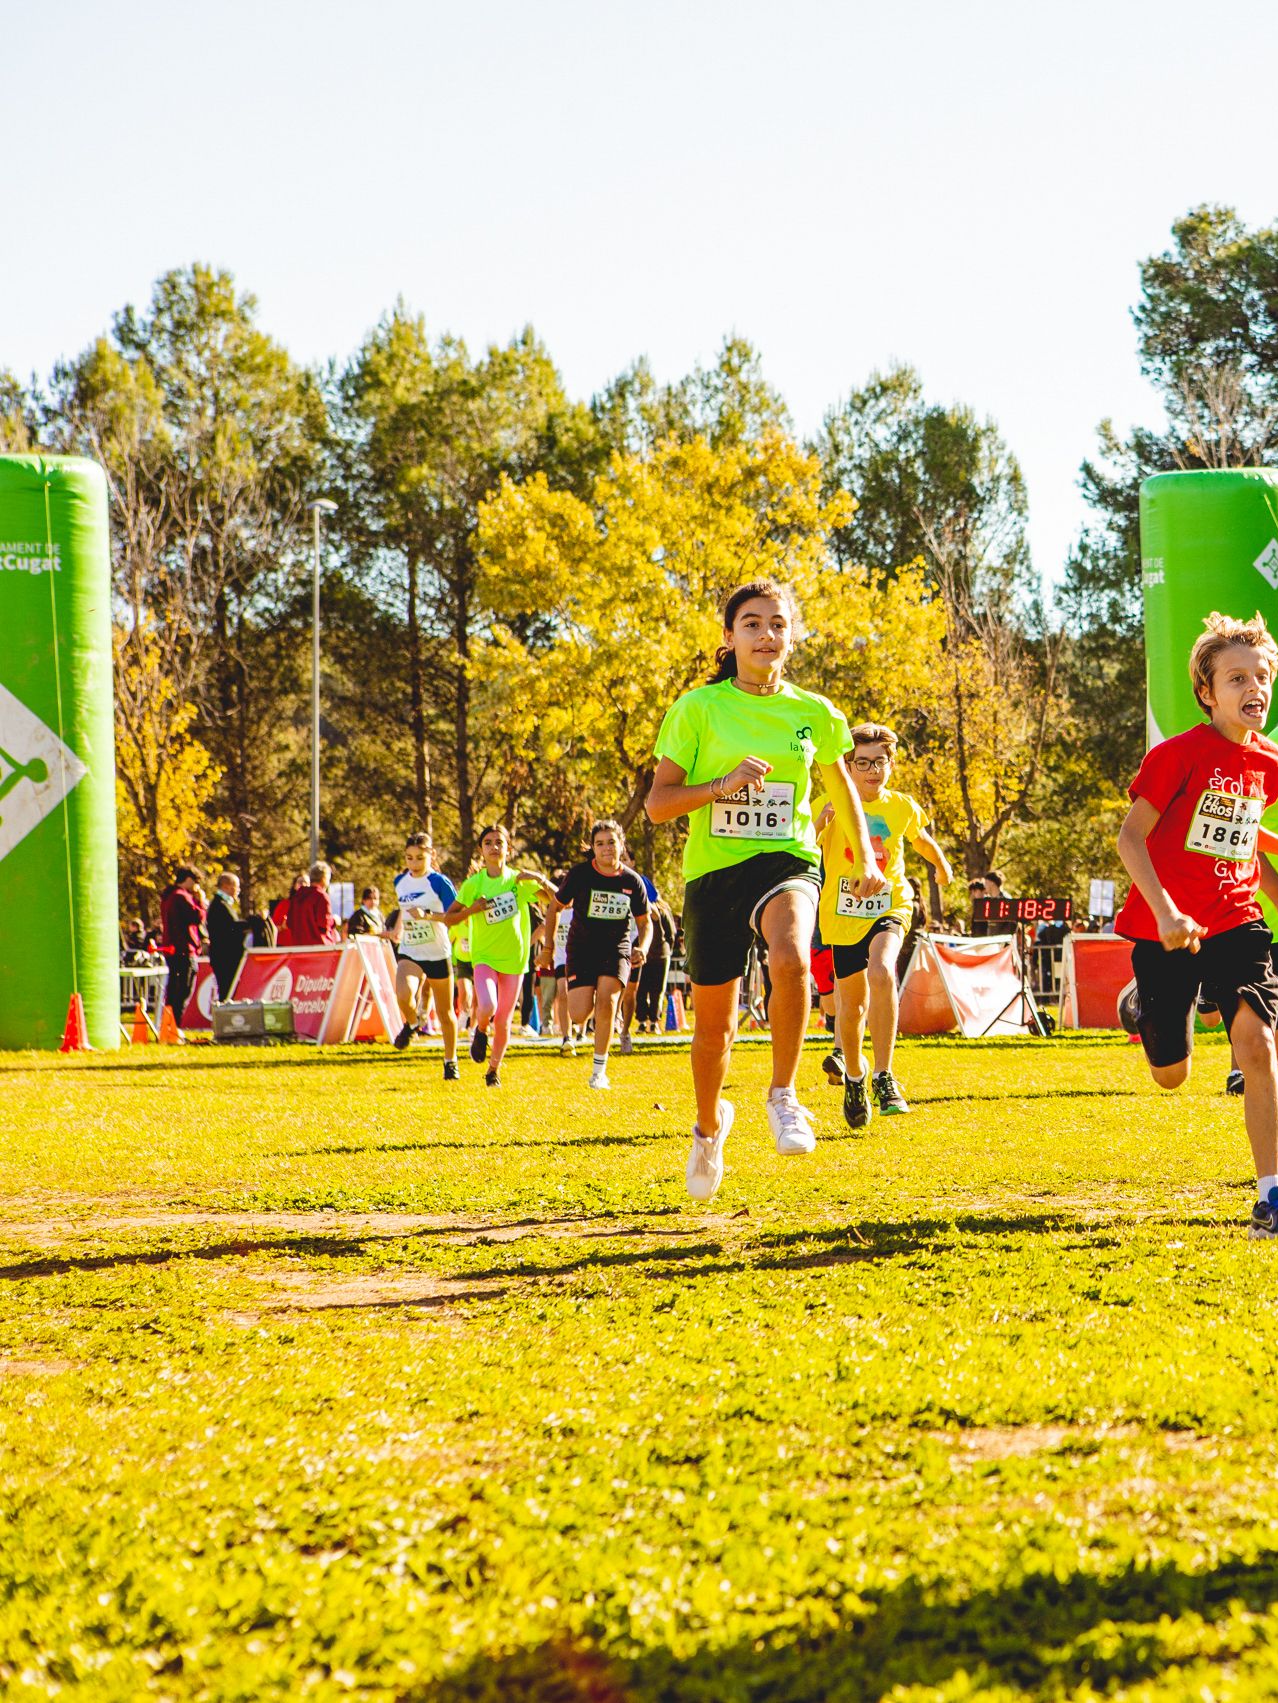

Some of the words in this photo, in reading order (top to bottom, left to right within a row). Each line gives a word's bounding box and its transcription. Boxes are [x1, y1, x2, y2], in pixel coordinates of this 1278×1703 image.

[724, 810, 778, 828] 1016
[1202, 803, 1233, 818] CROS
[1202, 823, 1249, 846] 1864
[984, 900, 1070, 919] 11:18:21
